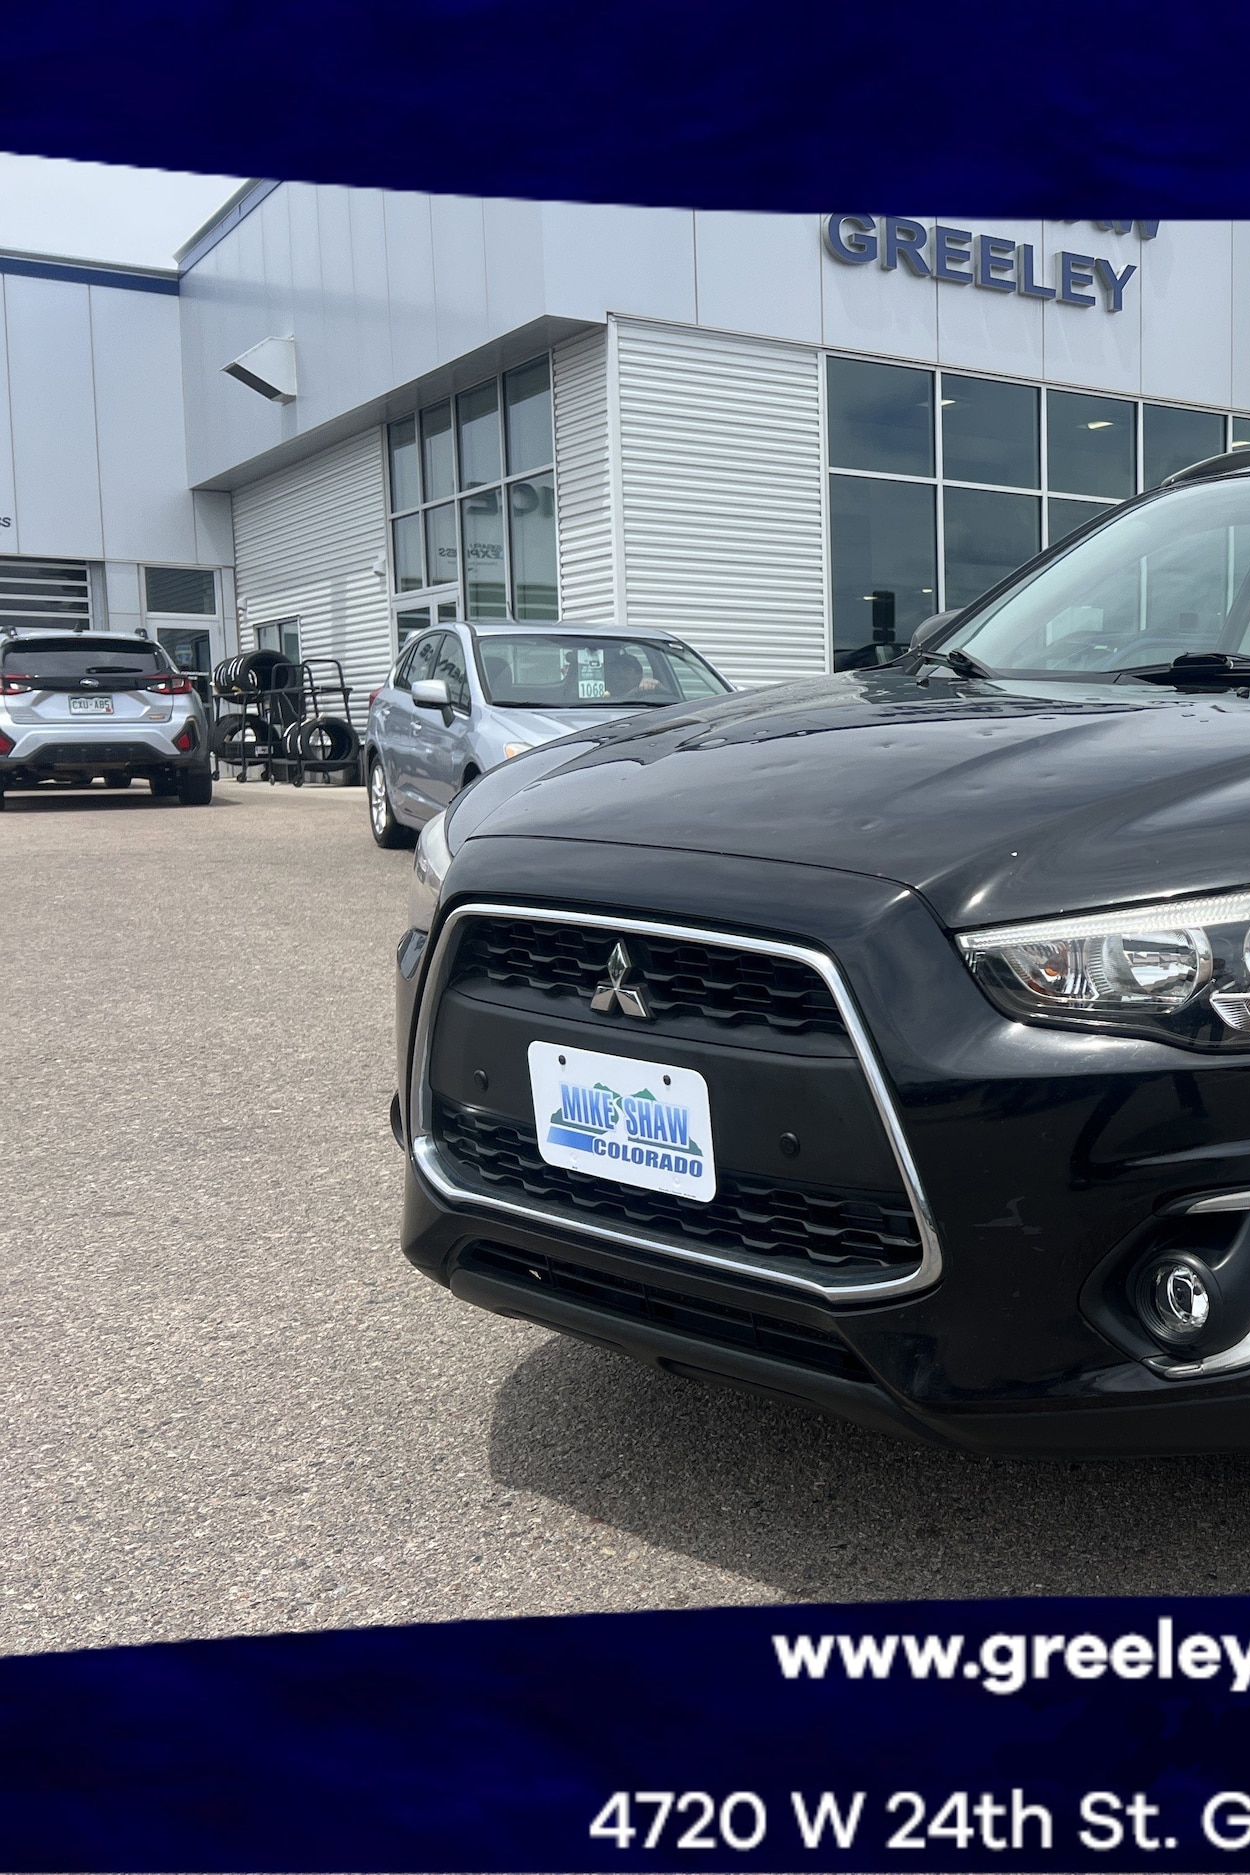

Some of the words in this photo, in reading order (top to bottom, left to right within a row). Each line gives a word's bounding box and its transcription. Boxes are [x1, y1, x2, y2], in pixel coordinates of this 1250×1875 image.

[823, 211, 1138, 312] GREELEY
[580, 682, 604, 698] 1068
[560, 1083, 615, 1131] MIKE
[621, 1097, 689, 1147] SHAW
[593, 1138, 704, 1178] COLORADO
